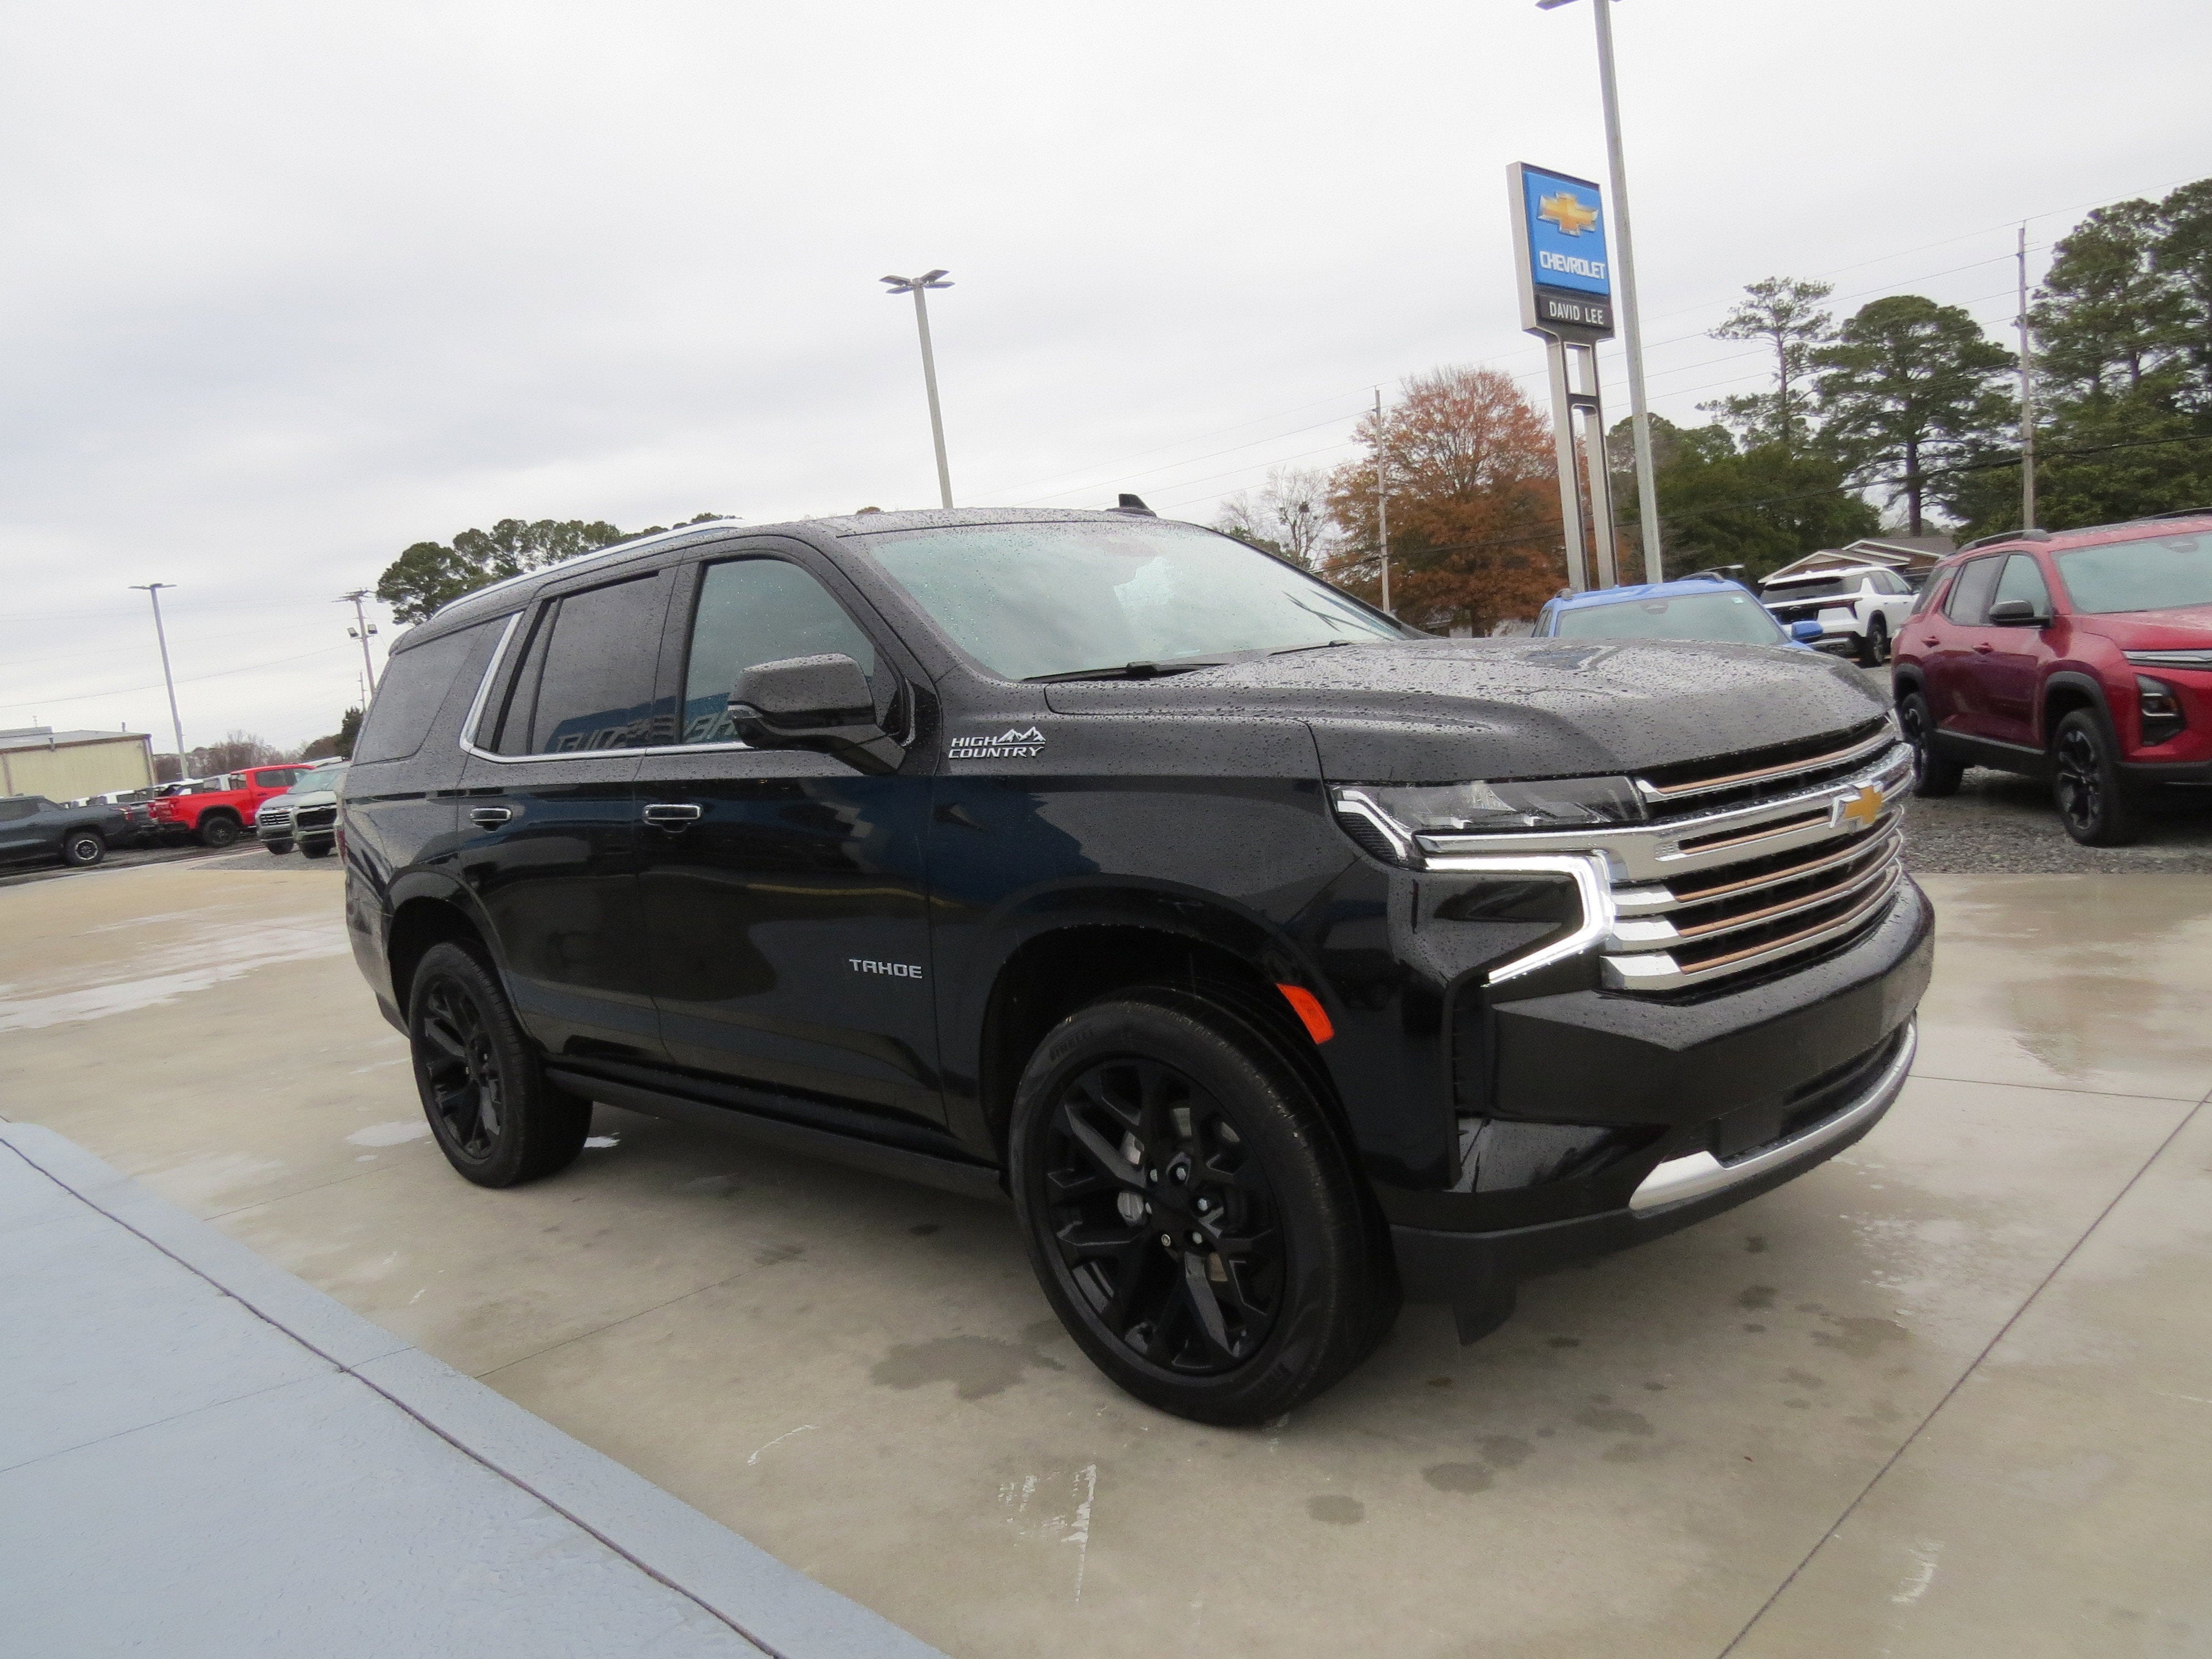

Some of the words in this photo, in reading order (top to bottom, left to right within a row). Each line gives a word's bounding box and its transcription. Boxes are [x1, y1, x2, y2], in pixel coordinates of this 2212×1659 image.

[1539, 251, 1605, 280] CHEVROLET
[1549, 301, 1580, 321] DAVID
[1585, 307, 1604, 325] LEE
[951, 736, 998, 747] HIGH
[948, 747, 1045, 758] COUNTRY
[848, 958, 923, 979] TAHOE
